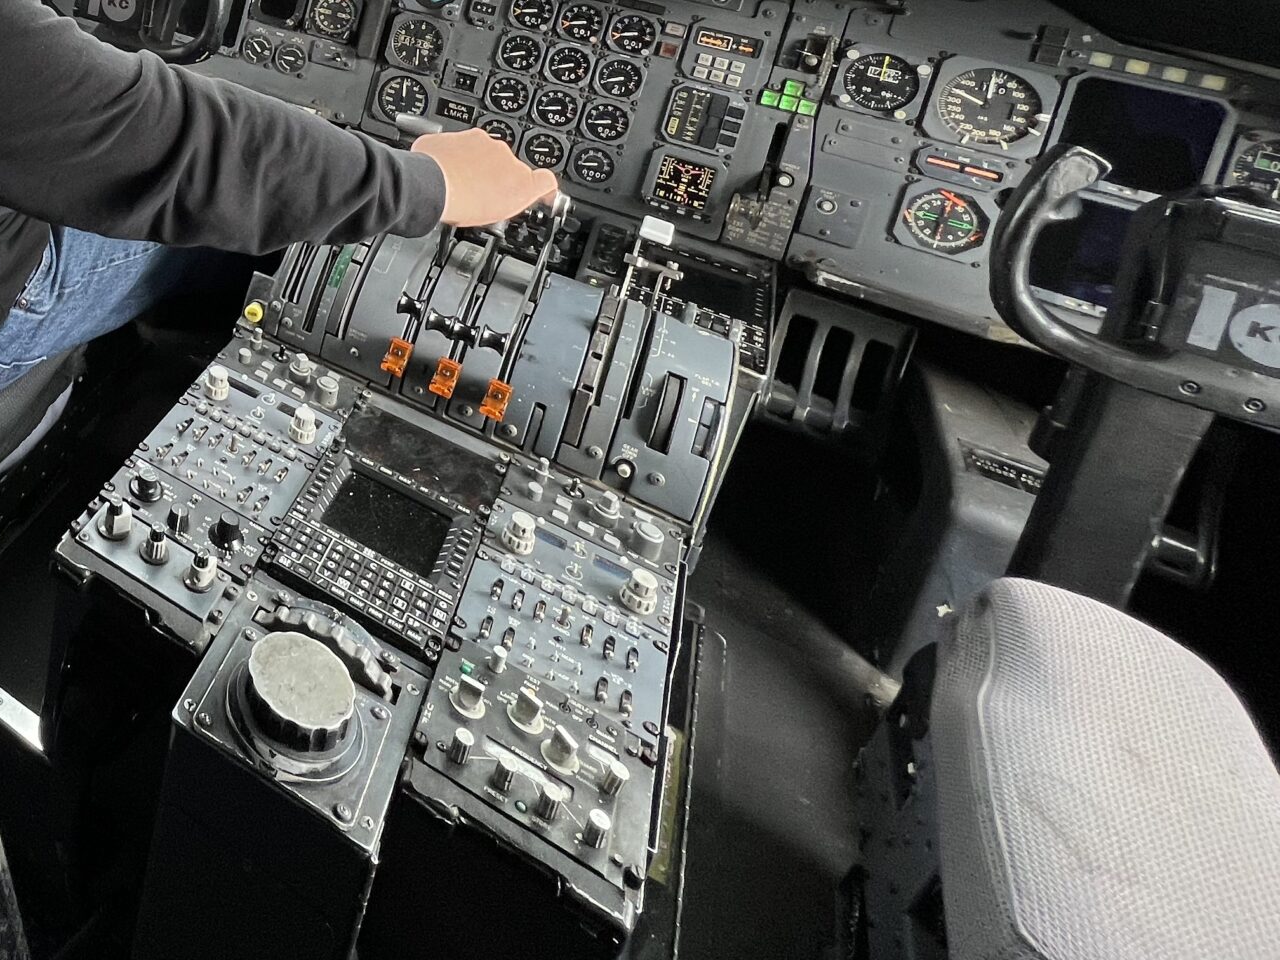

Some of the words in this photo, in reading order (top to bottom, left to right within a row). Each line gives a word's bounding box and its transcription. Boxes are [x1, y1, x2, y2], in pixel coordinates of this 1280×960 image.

[1246, 320, 1280, 343] K
[527, 675, 540, 685] TEST
[589, 734, 619, 755] CHANNEL
[511, 745, 548, 771] FREQUENCY
[484, 786, 508, 802] PRESET
